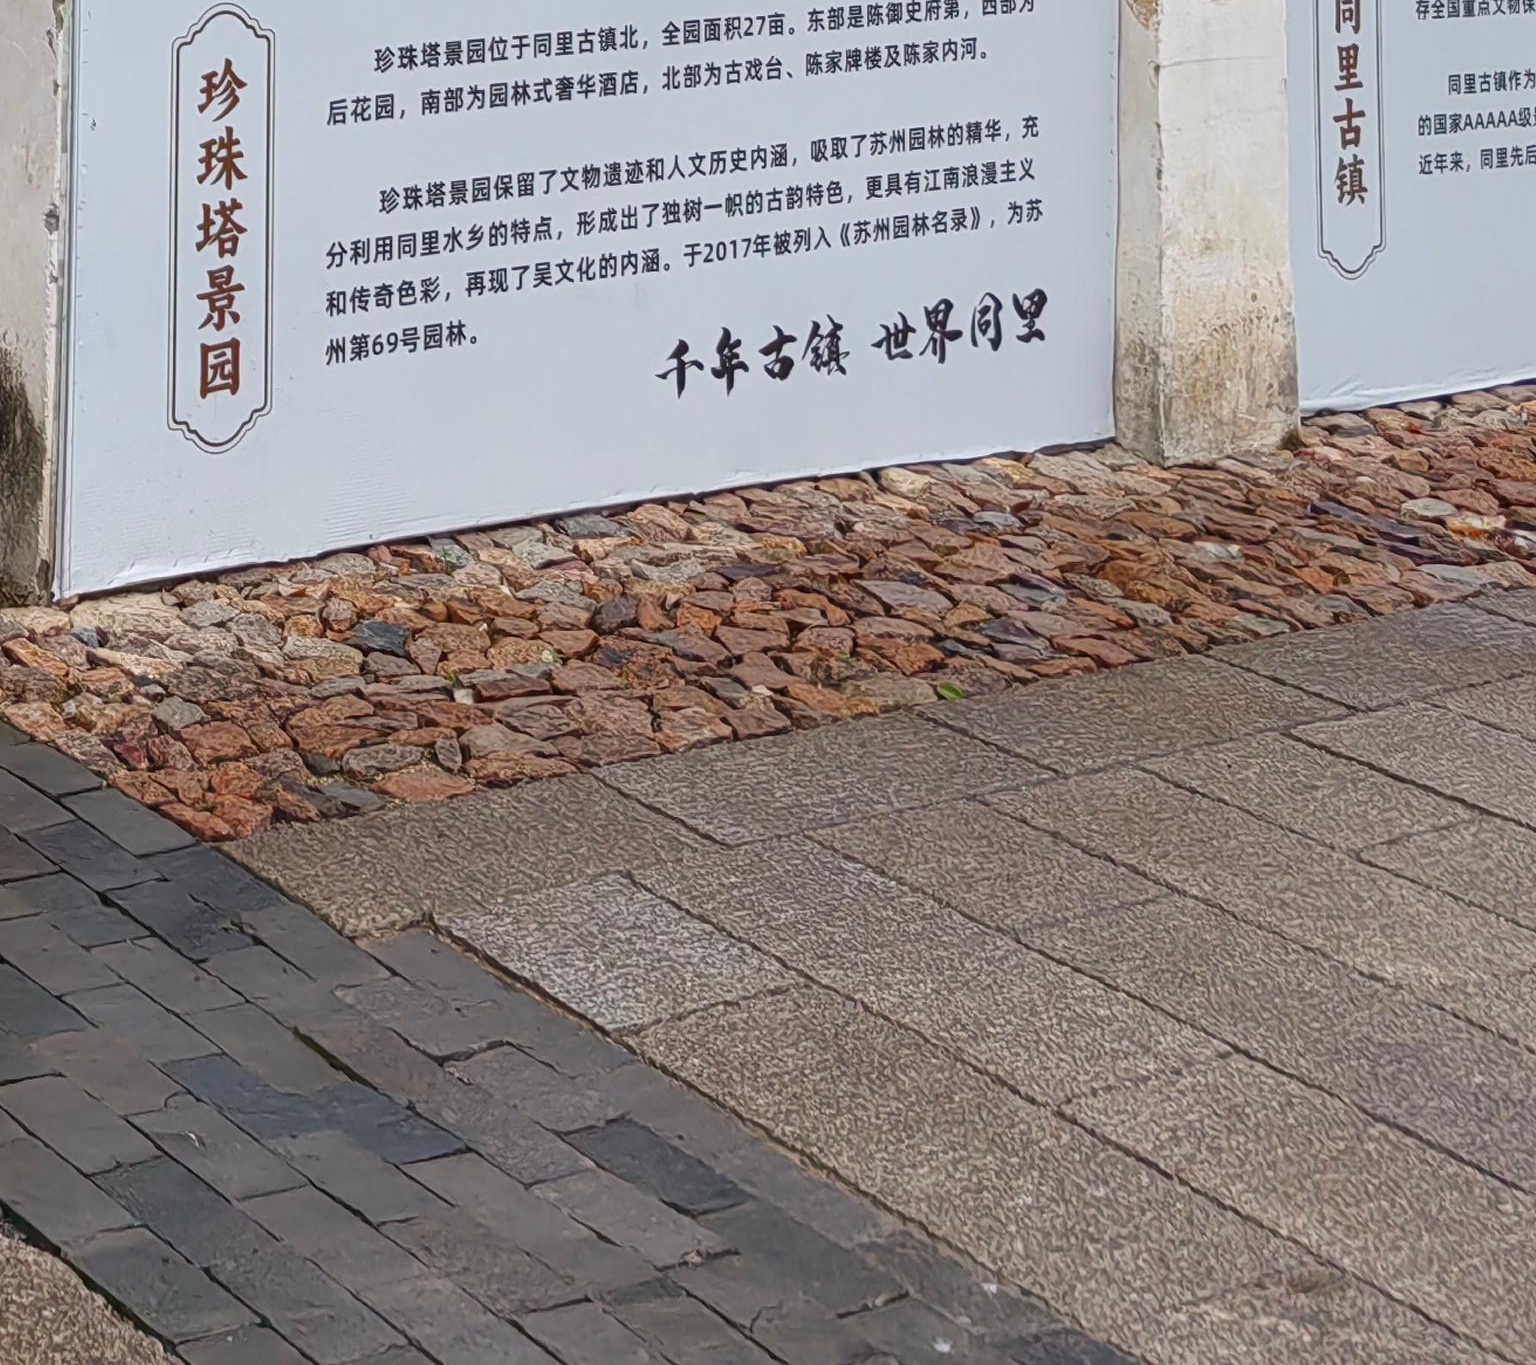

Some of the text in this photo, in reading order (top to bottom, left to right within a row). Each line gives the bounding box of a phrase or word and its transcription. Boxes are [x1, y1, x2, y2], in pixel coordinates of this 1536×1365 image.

[1448, 68, 1536, 96] 同里古镇作为
[1418, 106, 1536, 137] 的国家AAAAA级
[195, 58, 248, 400] 珍珠塔景园
[325, 319, 478, 366] 州第69号园林。
[871, 287, 1049, 364] 世界同里
